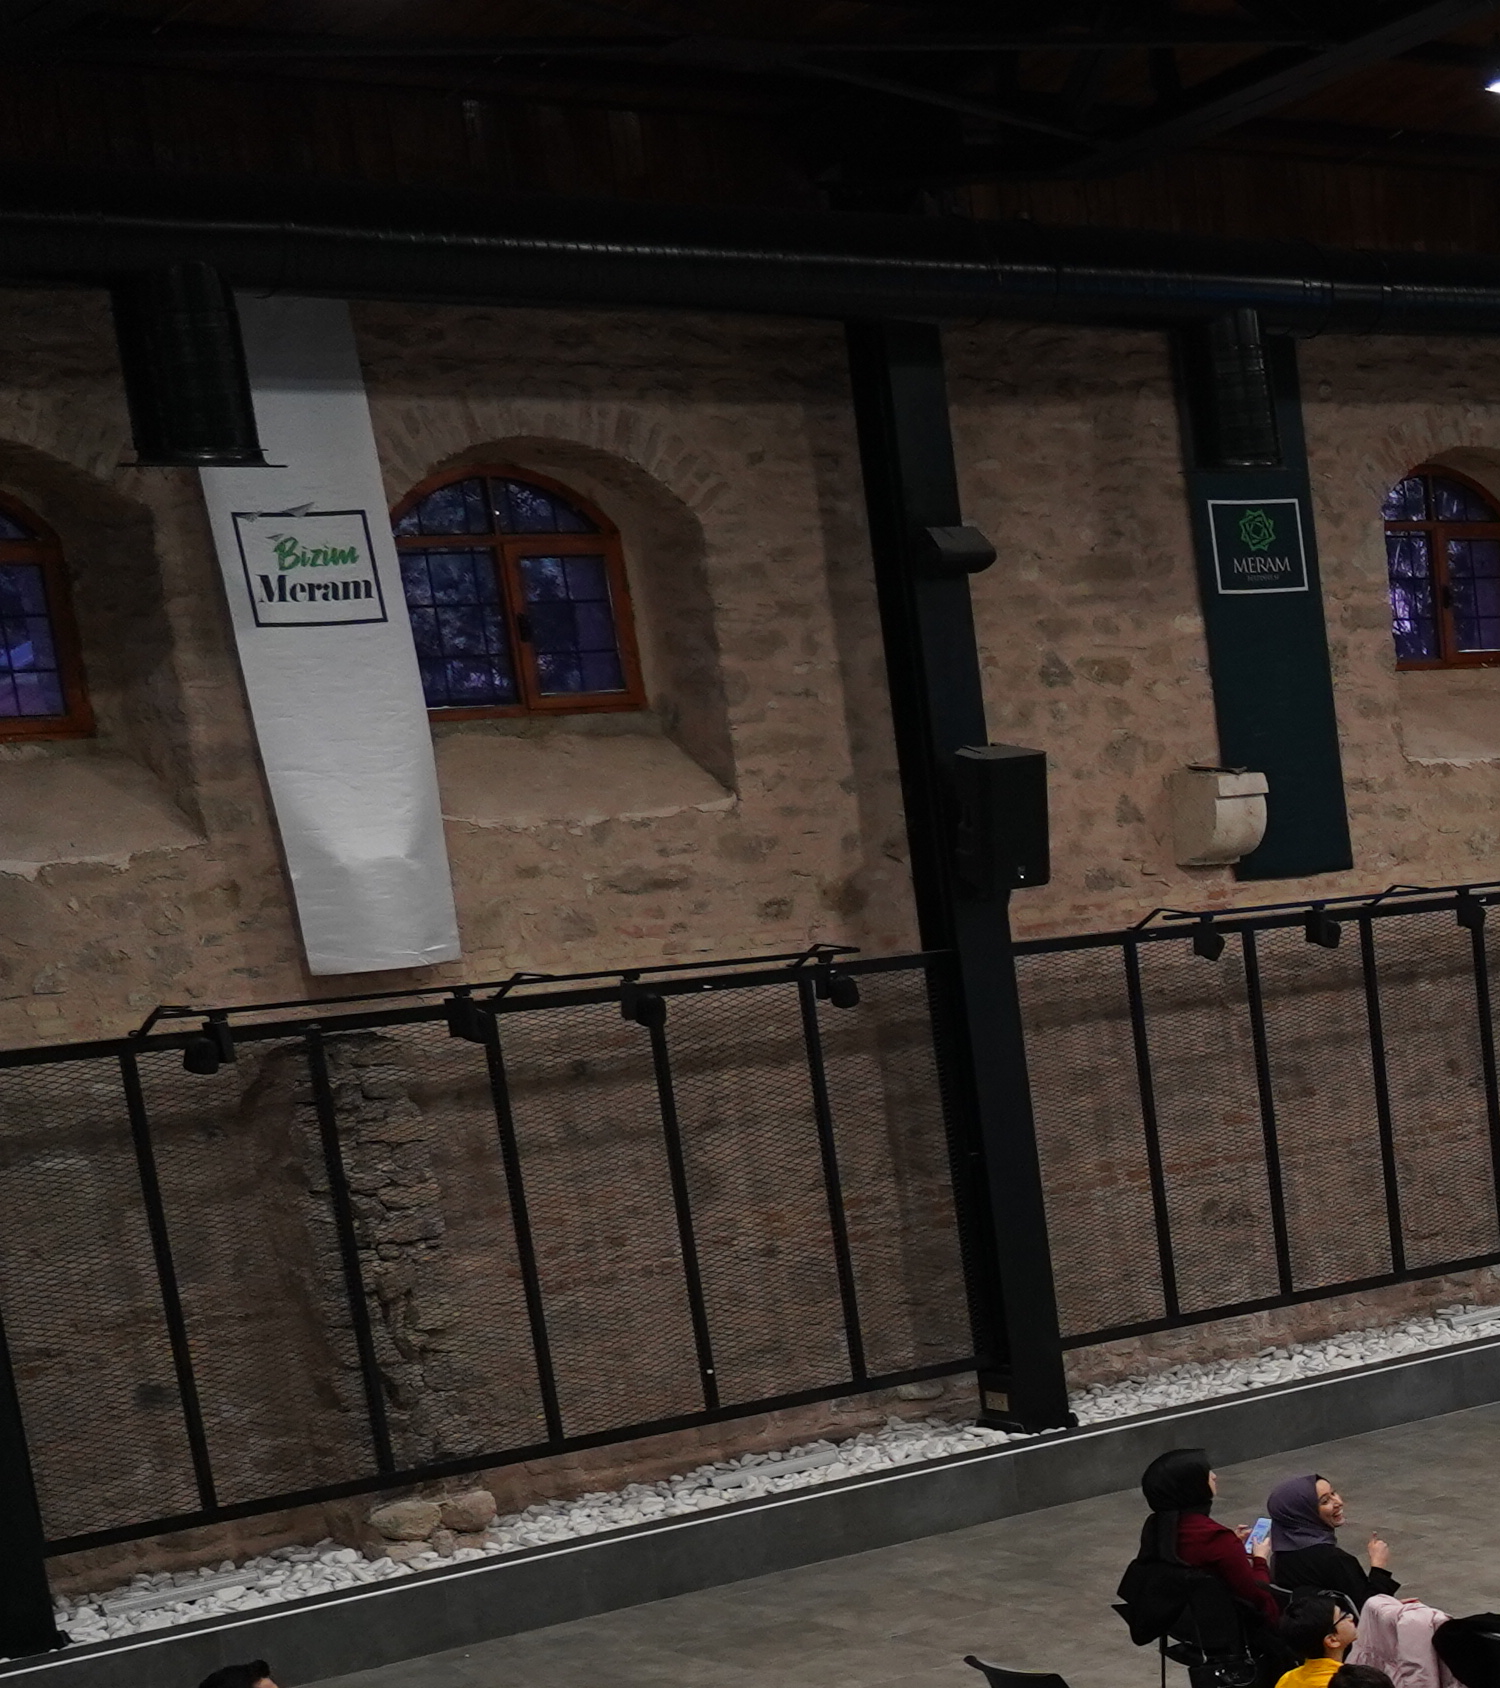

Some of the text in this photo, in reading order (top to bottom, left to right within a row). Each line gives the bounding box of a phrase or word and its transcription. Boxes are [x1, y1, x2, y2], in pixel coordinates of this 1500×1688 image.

[273, 536, 360, 572] Bizim
[1233, 556, 1291, 574] MERAM
[255, 574, 375, 603] Meram
